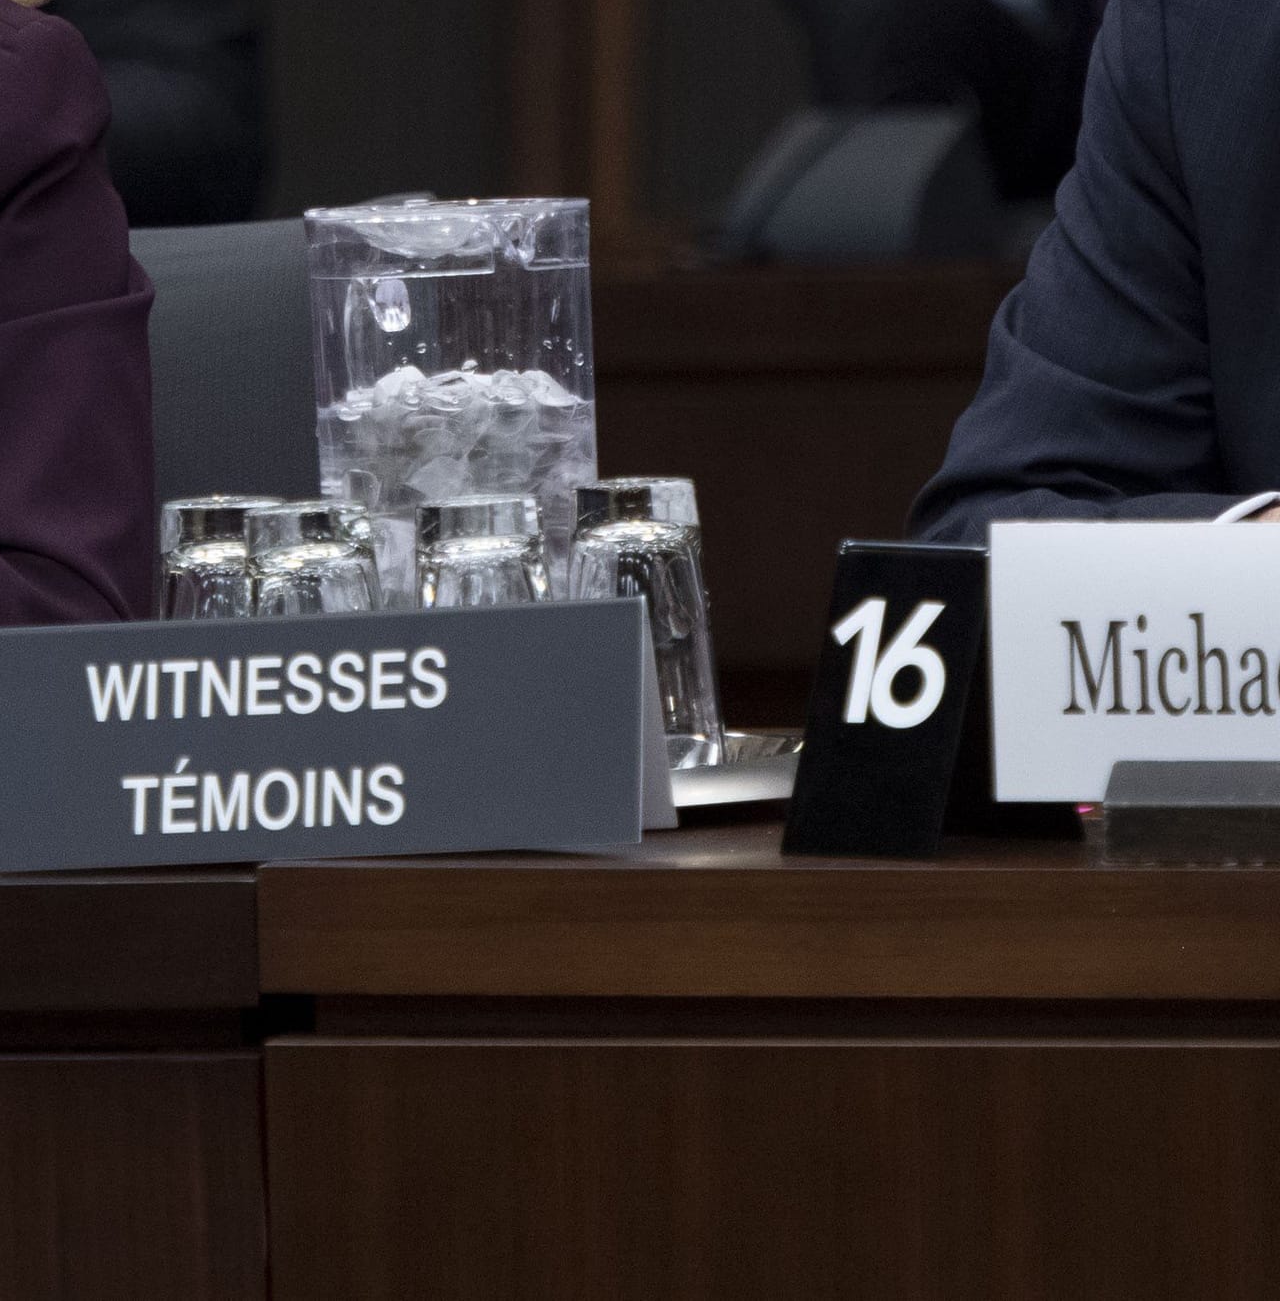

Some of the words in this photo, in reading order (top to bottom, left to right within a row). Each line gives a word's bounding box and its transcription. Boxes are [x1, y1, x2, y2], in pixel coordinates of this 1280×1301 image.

[85, 646, 448, 724] WITNESSES
[832, 597, 947, 730] 16
[121, 756, 406, 836] TÉMOINS
